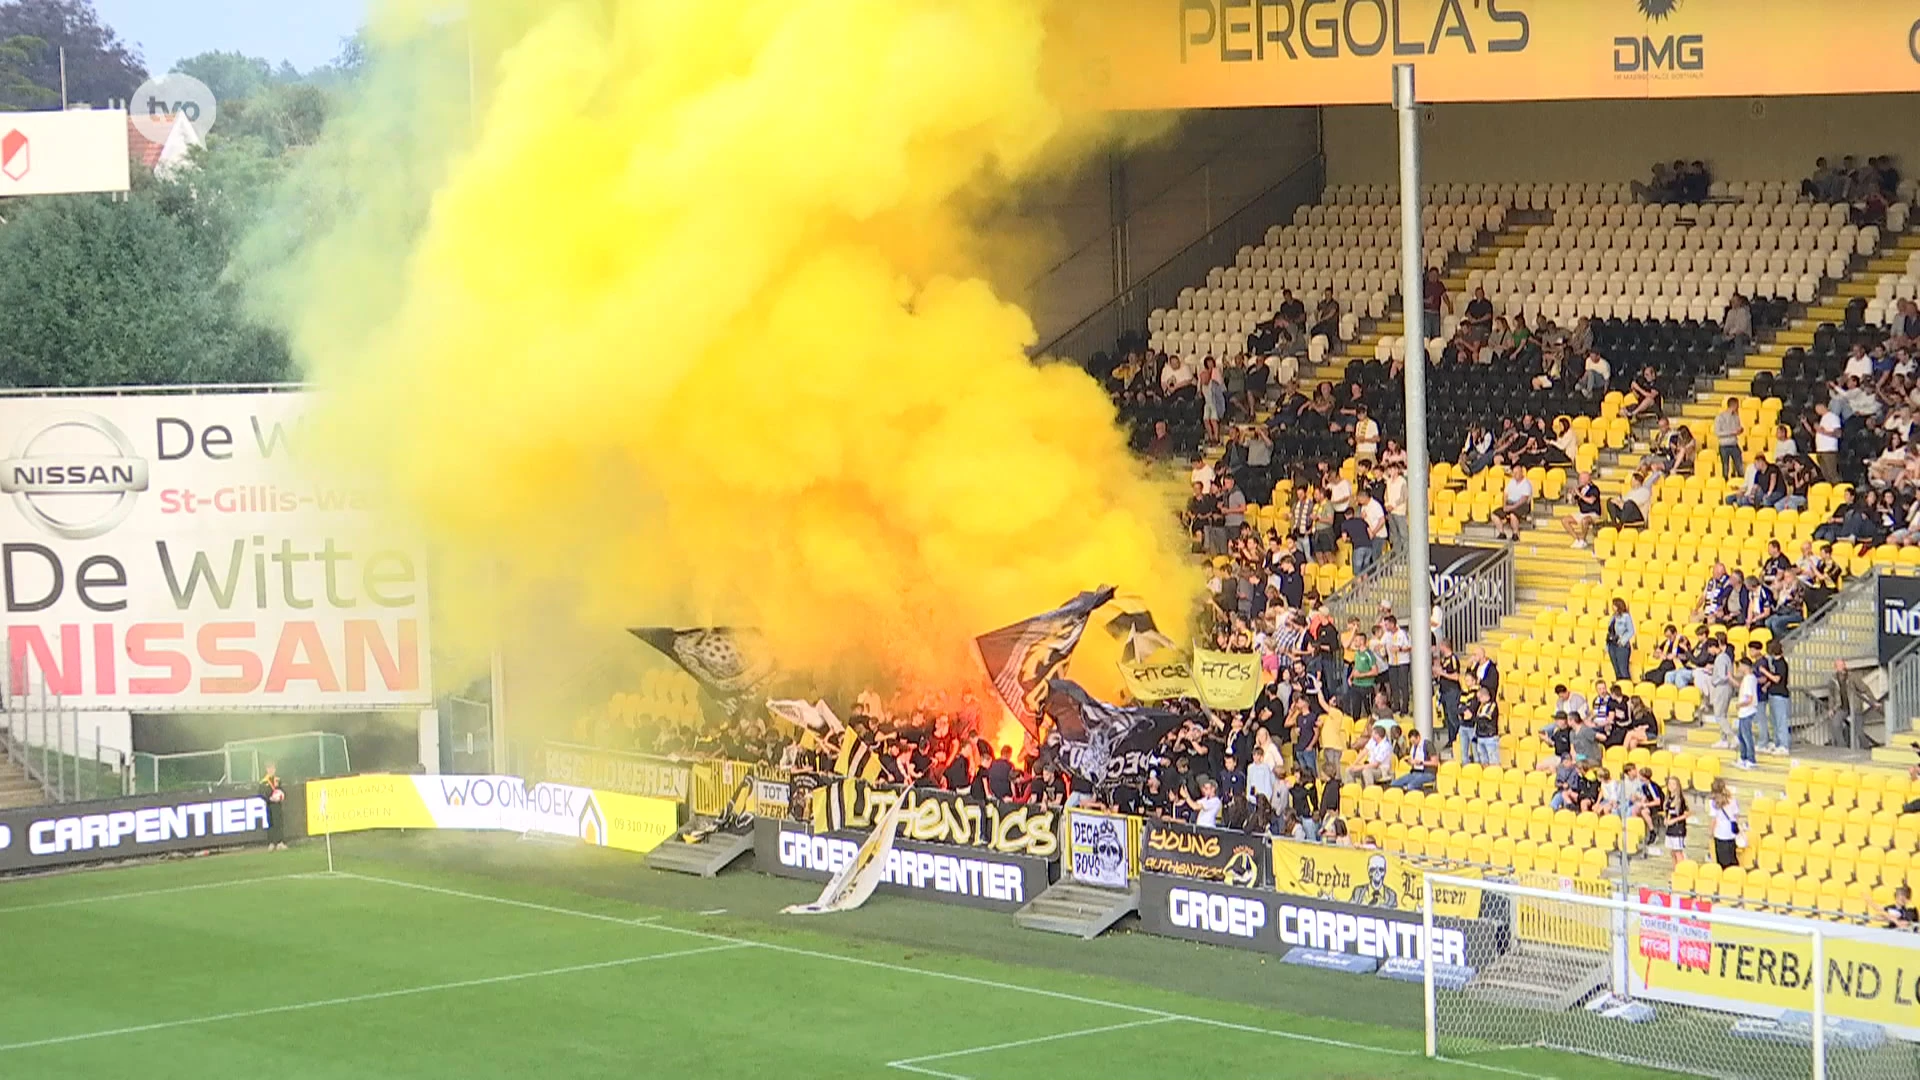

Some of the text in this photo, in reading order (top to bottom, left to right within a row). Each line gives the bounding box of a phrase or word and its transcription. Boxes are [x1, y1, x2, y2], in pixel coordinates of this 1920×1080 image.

[1180, 0, 1530, 64] PERGOLA'S
[1614, 34, 1704, 72] DMG
[156, 417, 234, 461] De
[13, 465, 134, 485] NISSAN
[2, 535, 417, 613] De Witte
[8, 619, 420, 697] NISSAN
[440, 778, 575, 818] WOONHOEK
[763, 784, 782, 801] TOT
[29, 797, 271, 856] CARPENTIER
[1148, 828, 1221, 858] YOUNG
[779, 830, 1025, 903] GROEP ARPENTIER
[1299, 856, 1468, 907] Breda Loeren
[1168, 887, 1467, 967] GROEP CARPENTIER
[1894, 967, 1920, 1006] L
